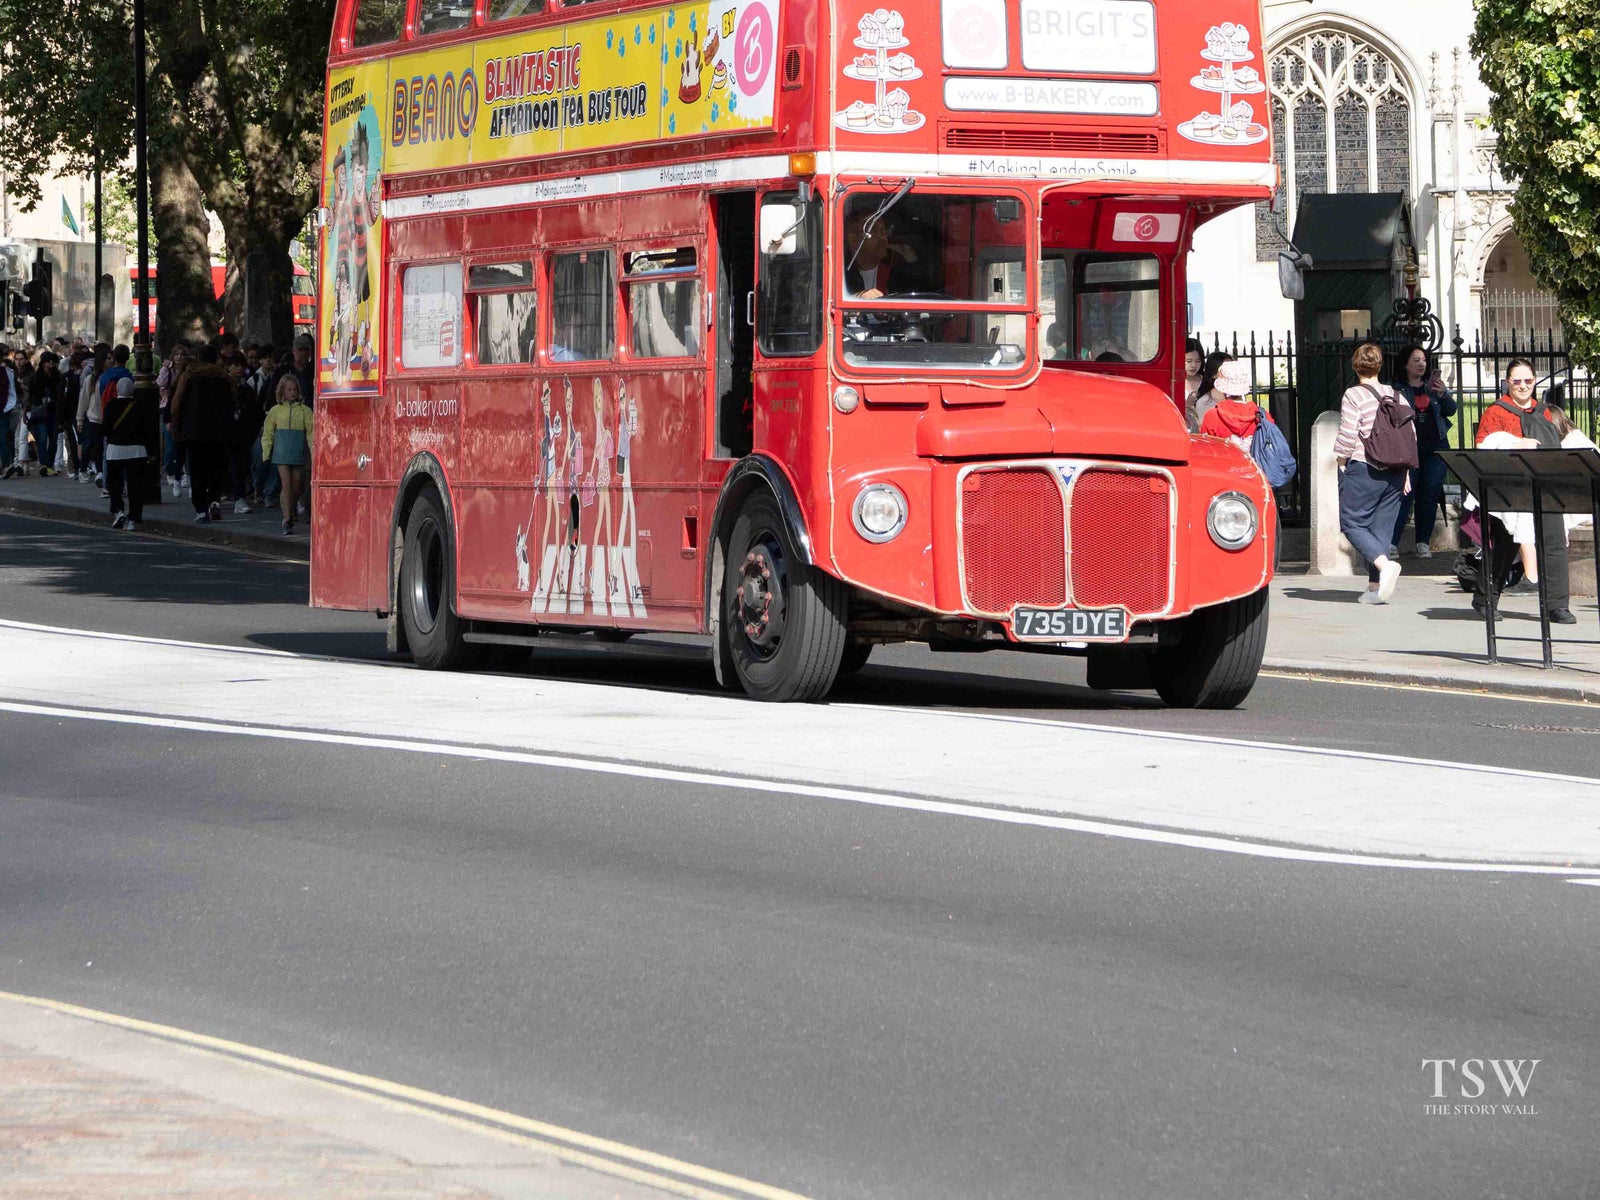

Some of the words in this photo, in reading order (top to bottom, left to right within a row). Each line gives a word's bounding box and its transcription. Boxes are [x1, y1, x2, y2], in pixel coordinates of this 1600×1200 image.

[722, 7, 736, 39] BY
[1026, 9, 1149, 39] BRIGIT'S
[485, 43, 581, 104] BLAMTASTIC
[330, 77, 355, 103] UTTERLY
[588, 88, 611, 125] BUS
[614, 82, 647, 120] TOUR
[958, 85, 1144, 109] www.B-BAKERY.com
[392, 68, 478, 147] BEANO
[396, 387, 458, 426] b-bakery.com
[1020, 611, 1066, 635] 735
[1072, 612, 1120, 636] DYE
